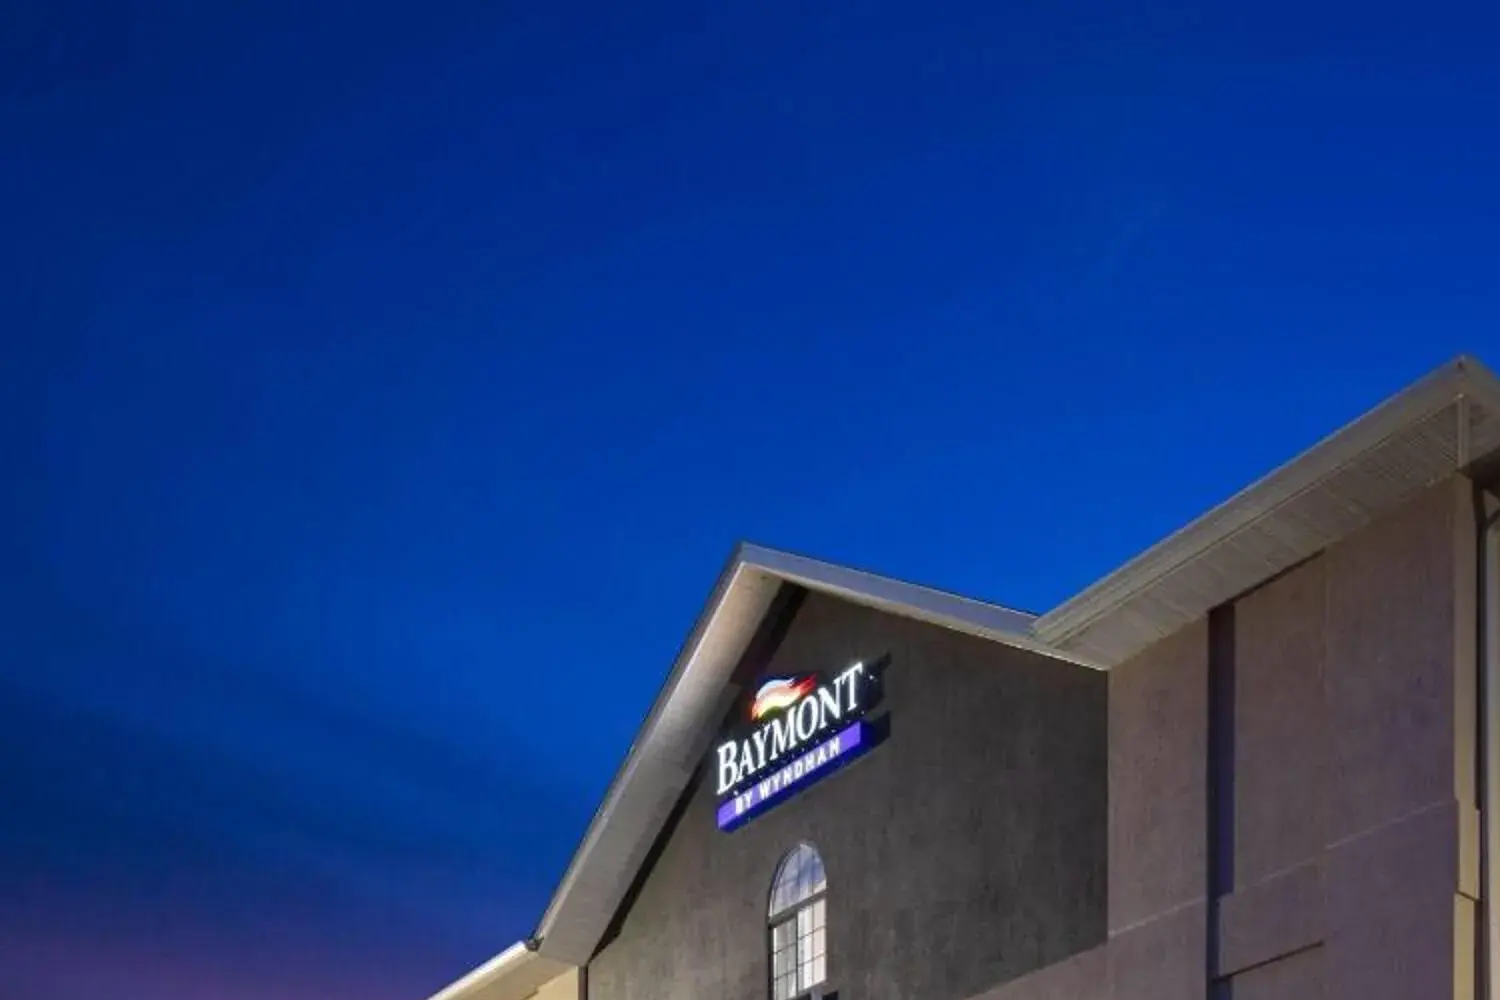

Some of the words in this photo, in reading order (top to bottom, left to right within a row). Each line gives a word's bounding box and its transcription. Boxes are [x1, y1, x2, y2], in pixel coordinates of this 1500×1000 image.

[716, 661, 863, 796] BAYMONT
[734, 791, 753, 815] BY
[758, 736, 841, 800] WYNDHAM
